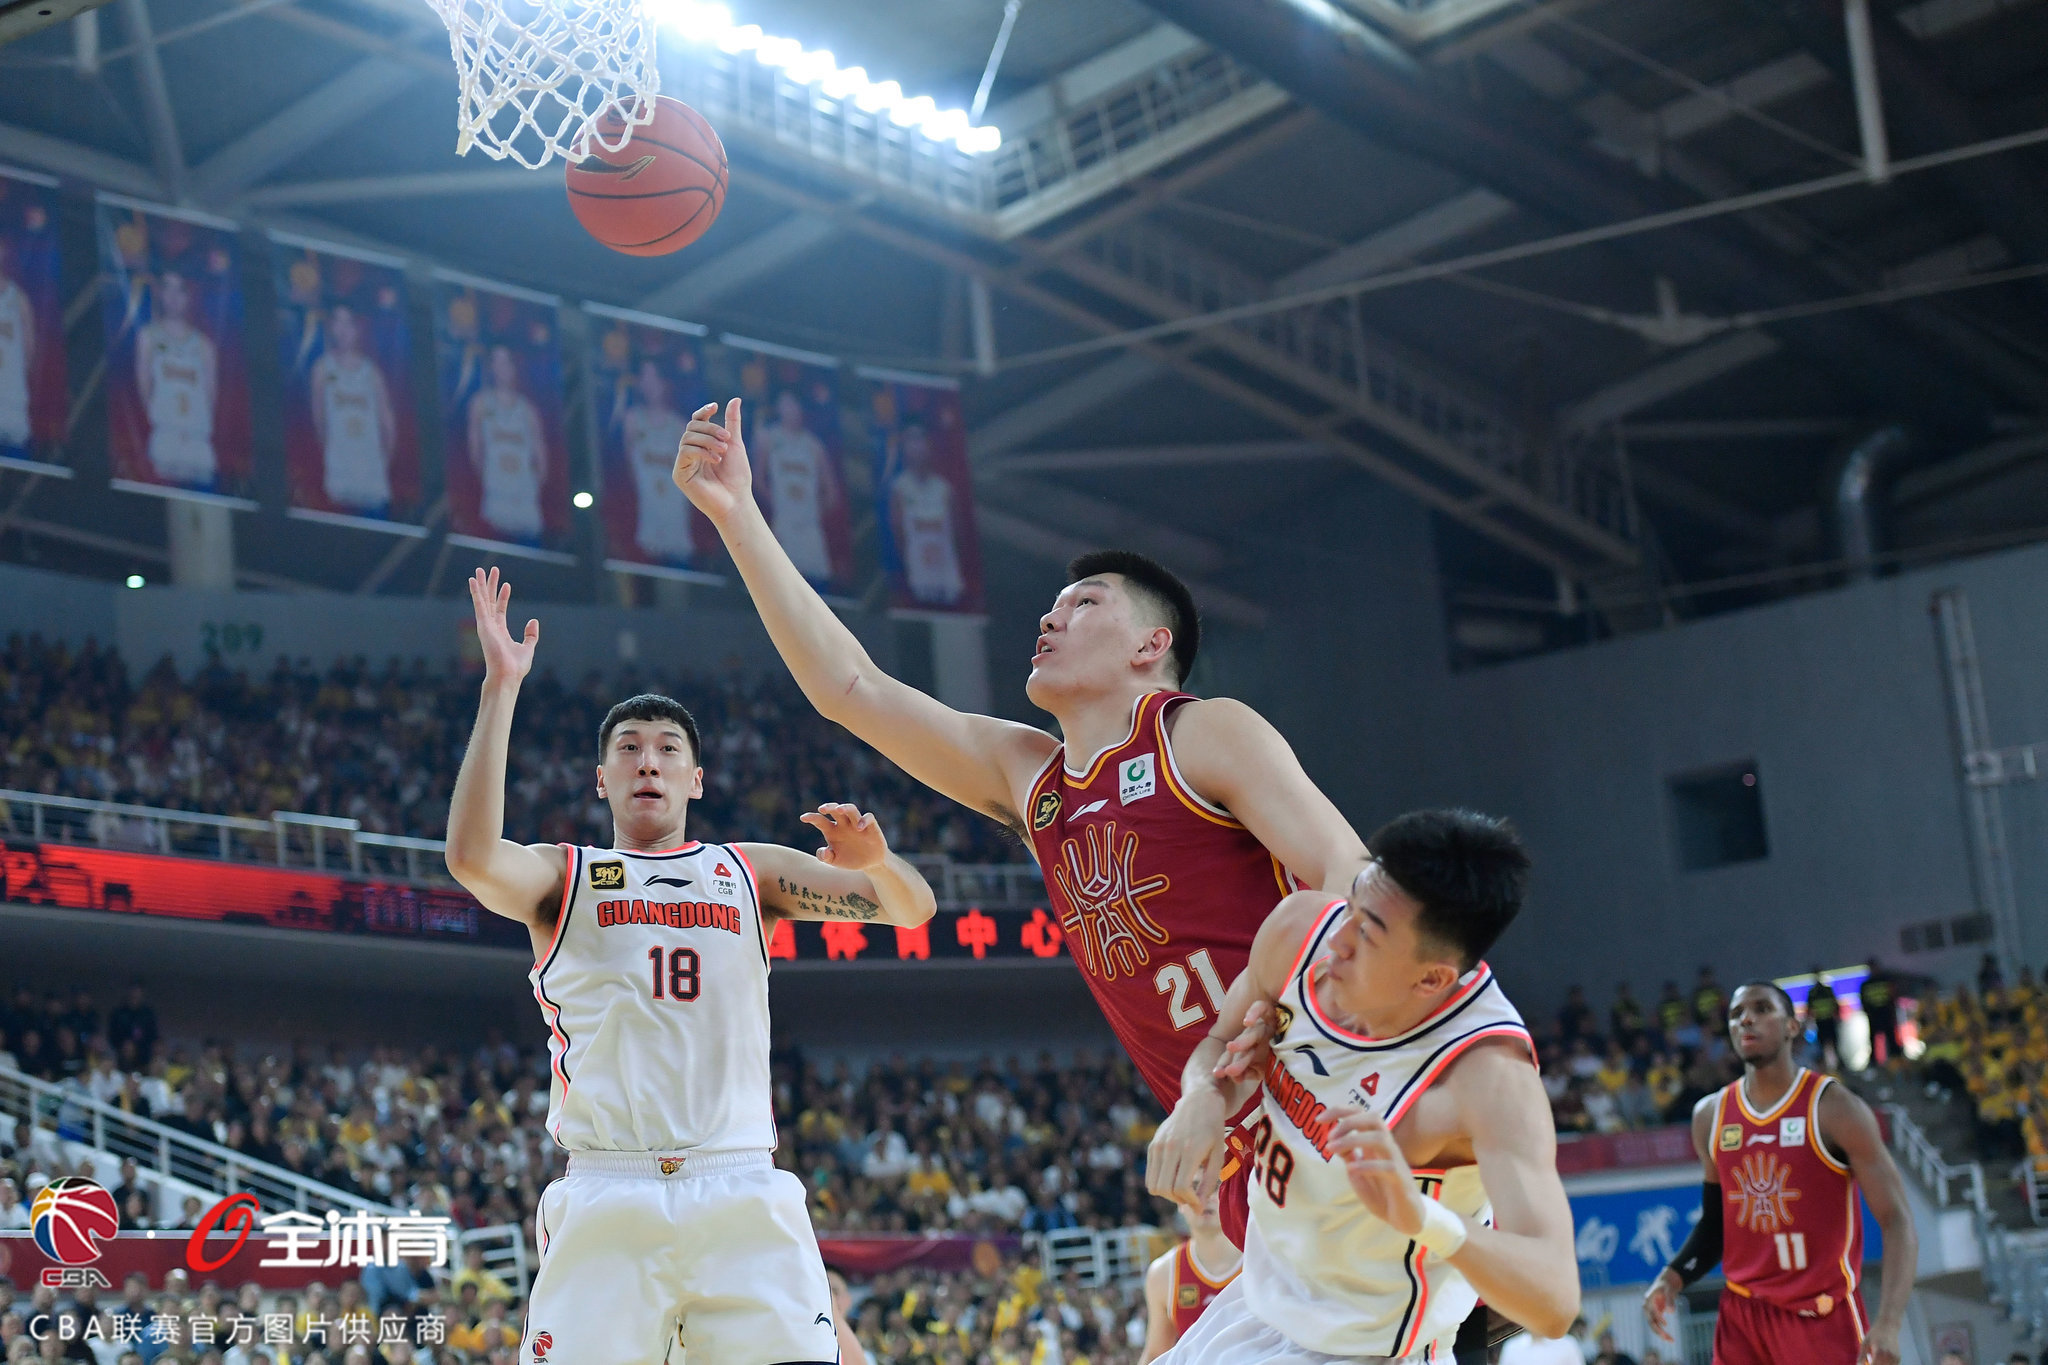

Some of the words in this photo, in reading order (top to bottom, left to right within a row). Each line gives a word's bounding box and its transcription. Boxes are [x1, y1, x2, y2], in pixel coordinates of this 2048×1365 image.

[718, 887, 733, 896] CGB
[597, 899, 741, 935] GUANGDONG
[648, 945, 701, 1002] 18
[1153, 948, 1229, 1031] 21
[1774, 1232, 1807, 1270] 11
